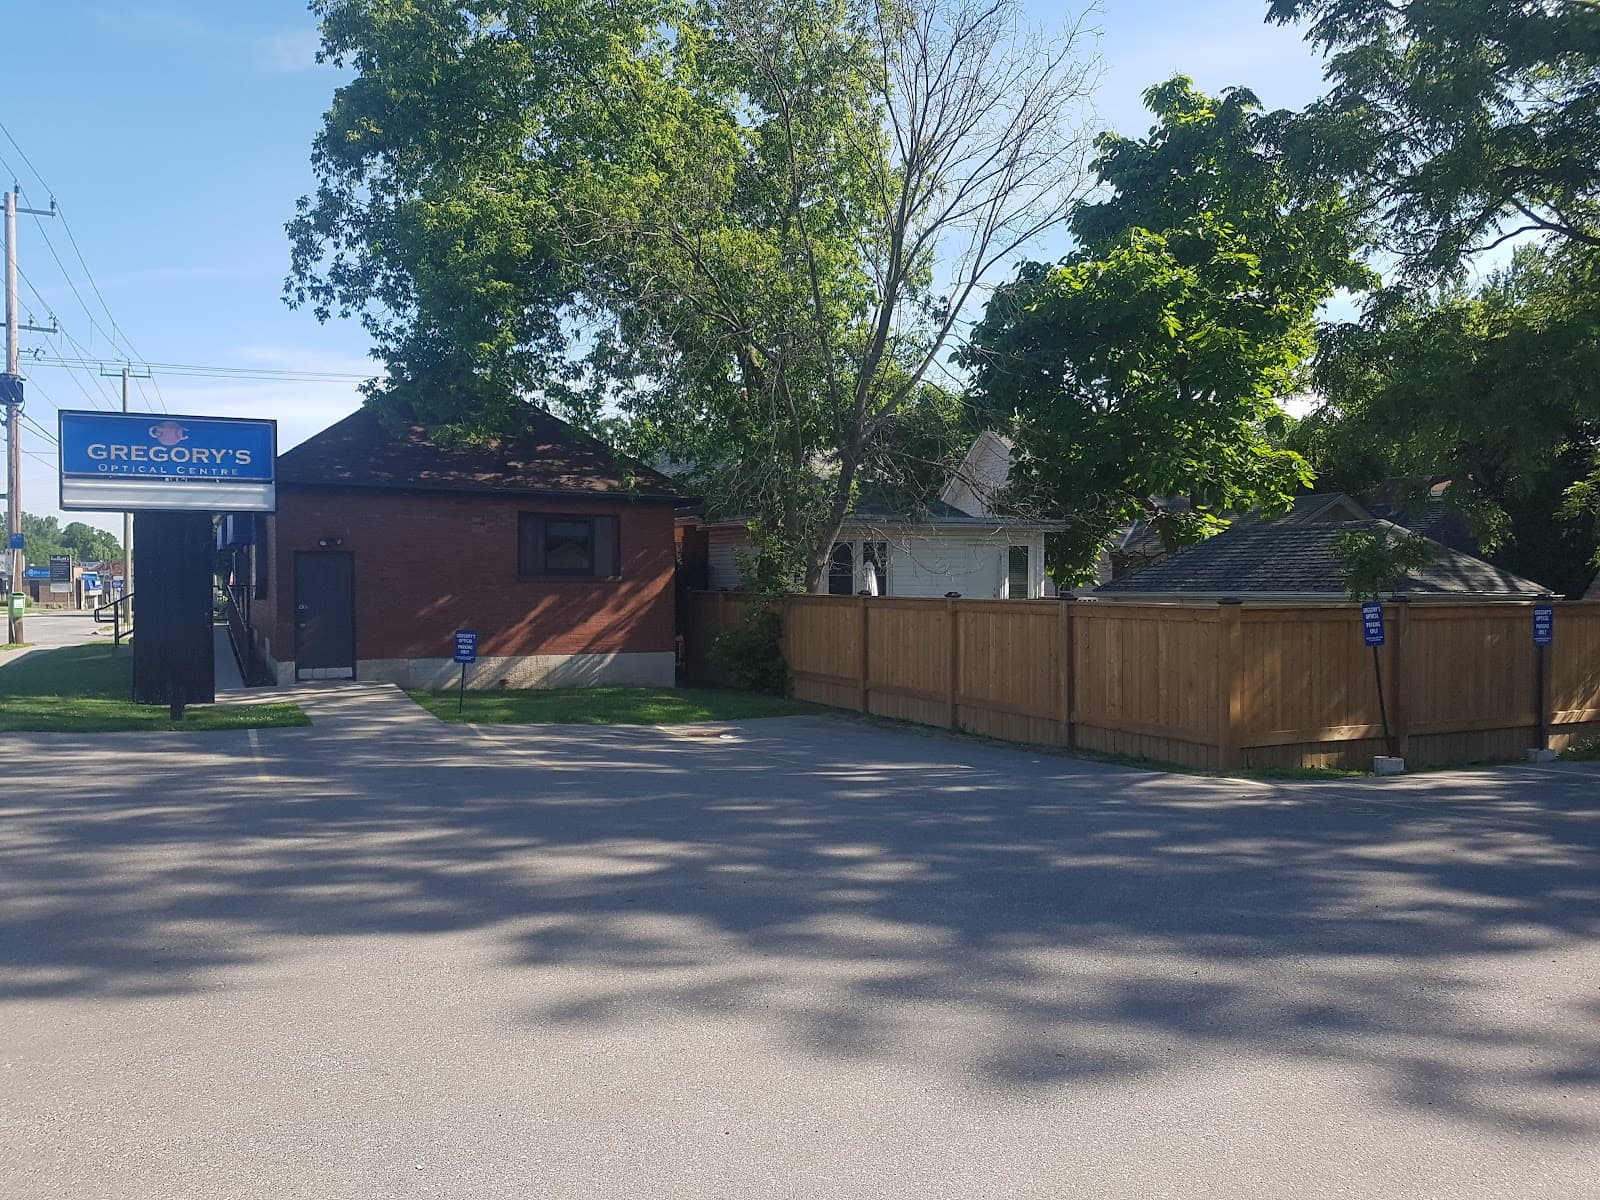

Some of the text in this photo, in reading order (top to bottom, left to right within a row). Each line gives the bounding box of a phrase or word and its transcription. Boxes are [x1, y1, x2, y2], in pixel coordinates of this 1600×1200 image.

[87, 443, 252, 465] GREGORY'S
[97, 463, 239, 476] OPTICAL CENTRE
